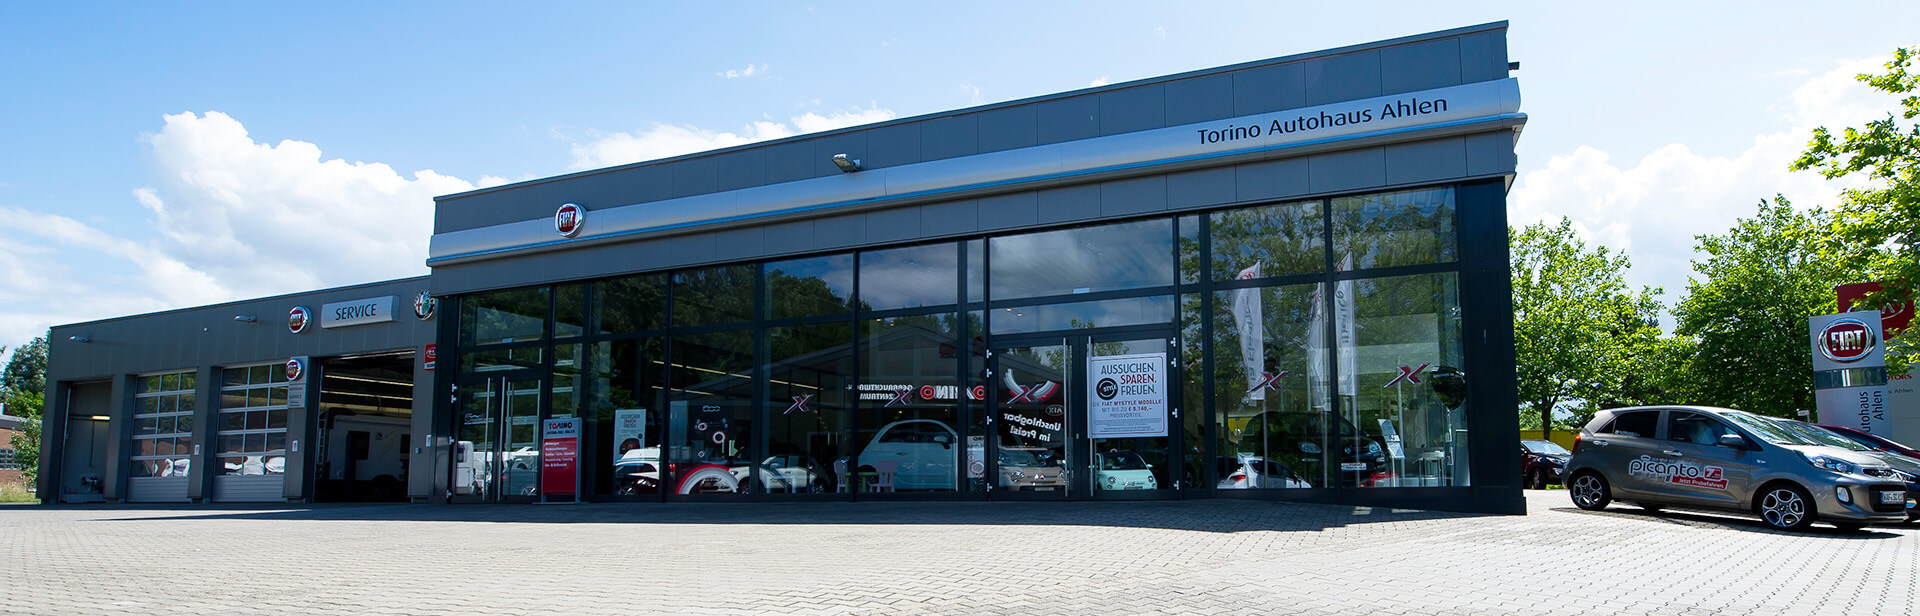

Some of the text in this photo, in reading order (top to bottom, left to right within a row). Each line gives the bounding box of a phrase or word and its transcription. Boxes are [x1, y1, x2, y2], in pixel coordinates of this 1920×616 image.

[1197, 97, 1448, 145] Torino Autohaus Ahlen
[559, 210, 576, 229] FIAT
[335, 303, 378, 321] SERVICE
[1830, 329, 1864, 351] FIAT
[1101, 363, 1156, 374] AUSSUCHEN.
[1121, 374, 1156, 385] SPAREN.
[1121, 385, 1156, 395] FREUEN.
[1858, 391, 1872, 433] utohaus
[1872, 389, 1885, 421] Ahlen
[1629, 456, 1699, 478] picanto
